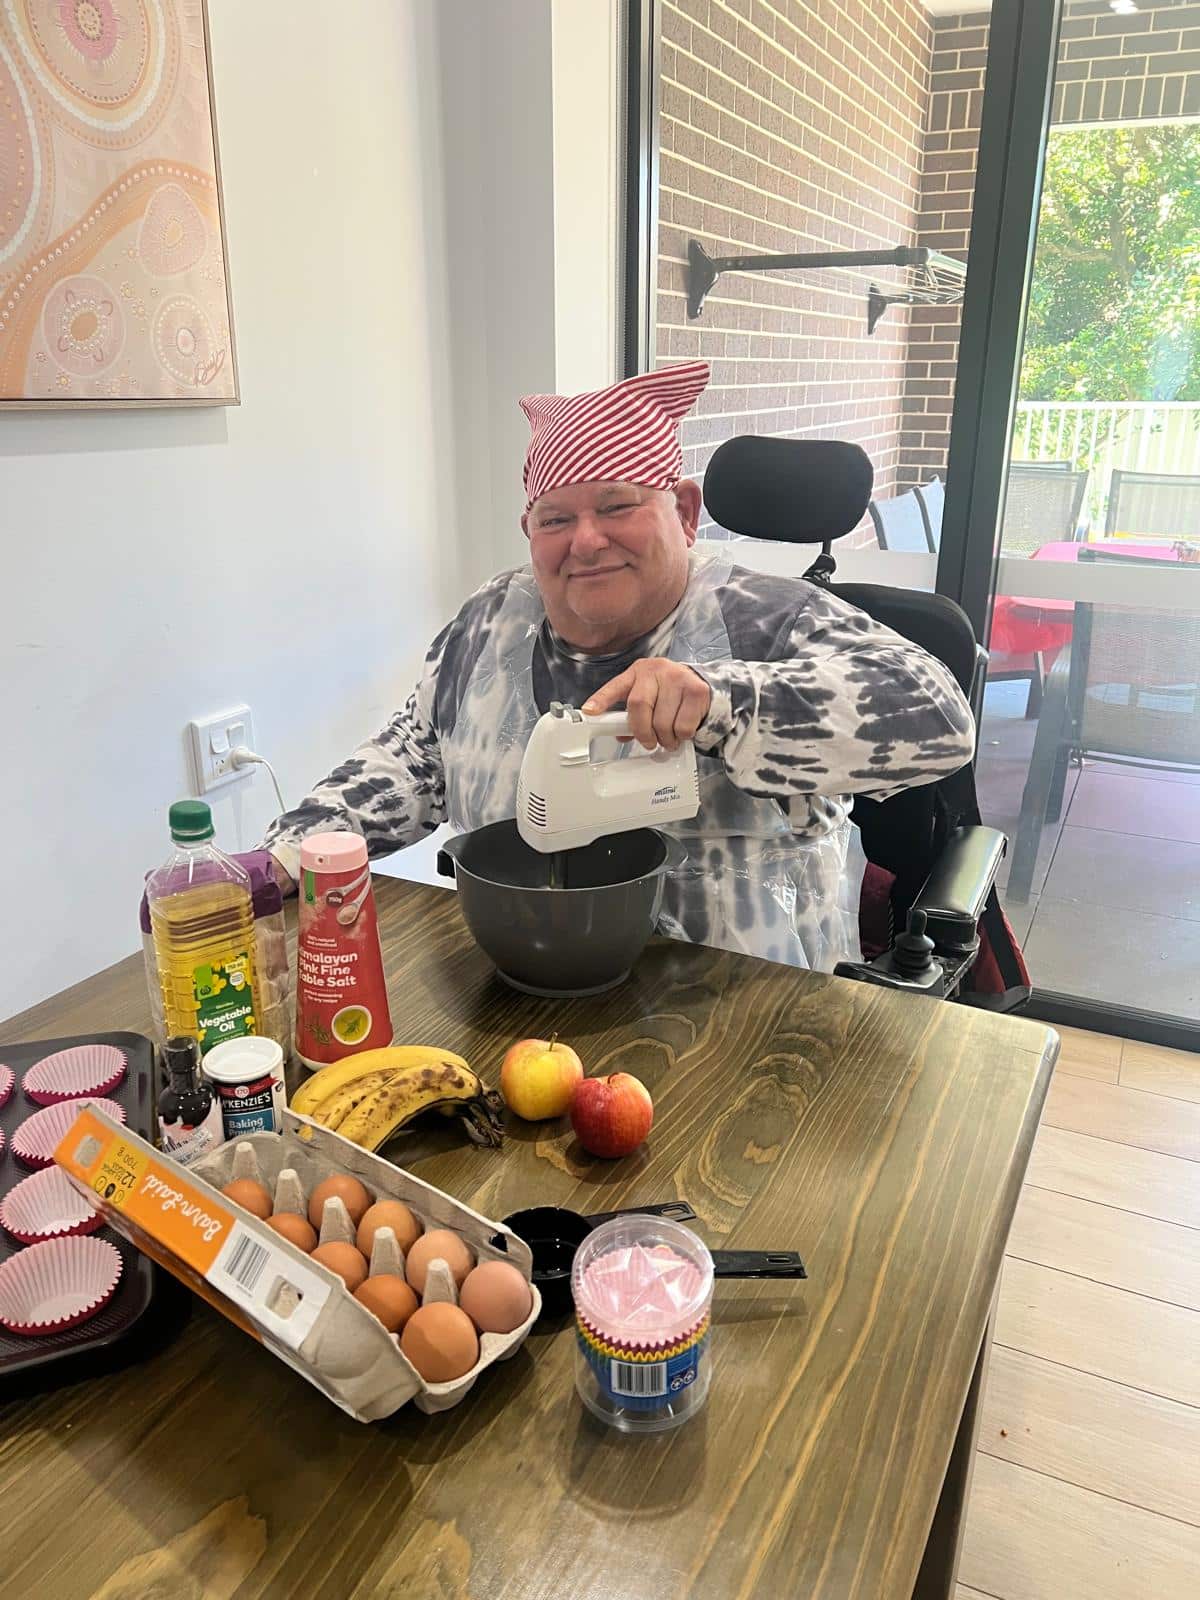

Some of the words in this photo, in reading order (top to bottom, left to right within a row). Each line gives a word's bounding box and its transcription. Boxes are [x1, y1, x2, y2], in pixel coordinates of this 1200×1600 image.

[321, 964, 351, 976] Fine
[327, 975, 357, 988] Salt
[199, 1006, 252, 1028] Vegetable
[219, 1020, 236, 1033] Oil
[228, 1117, 264, 1129] Baking
[123, 1154, 138, 1170] 700
[121, 1171, 137, 1188] 12
[141, 1174, 183, 1211] Laid
[180, 1200, 222, 1241] Barn
